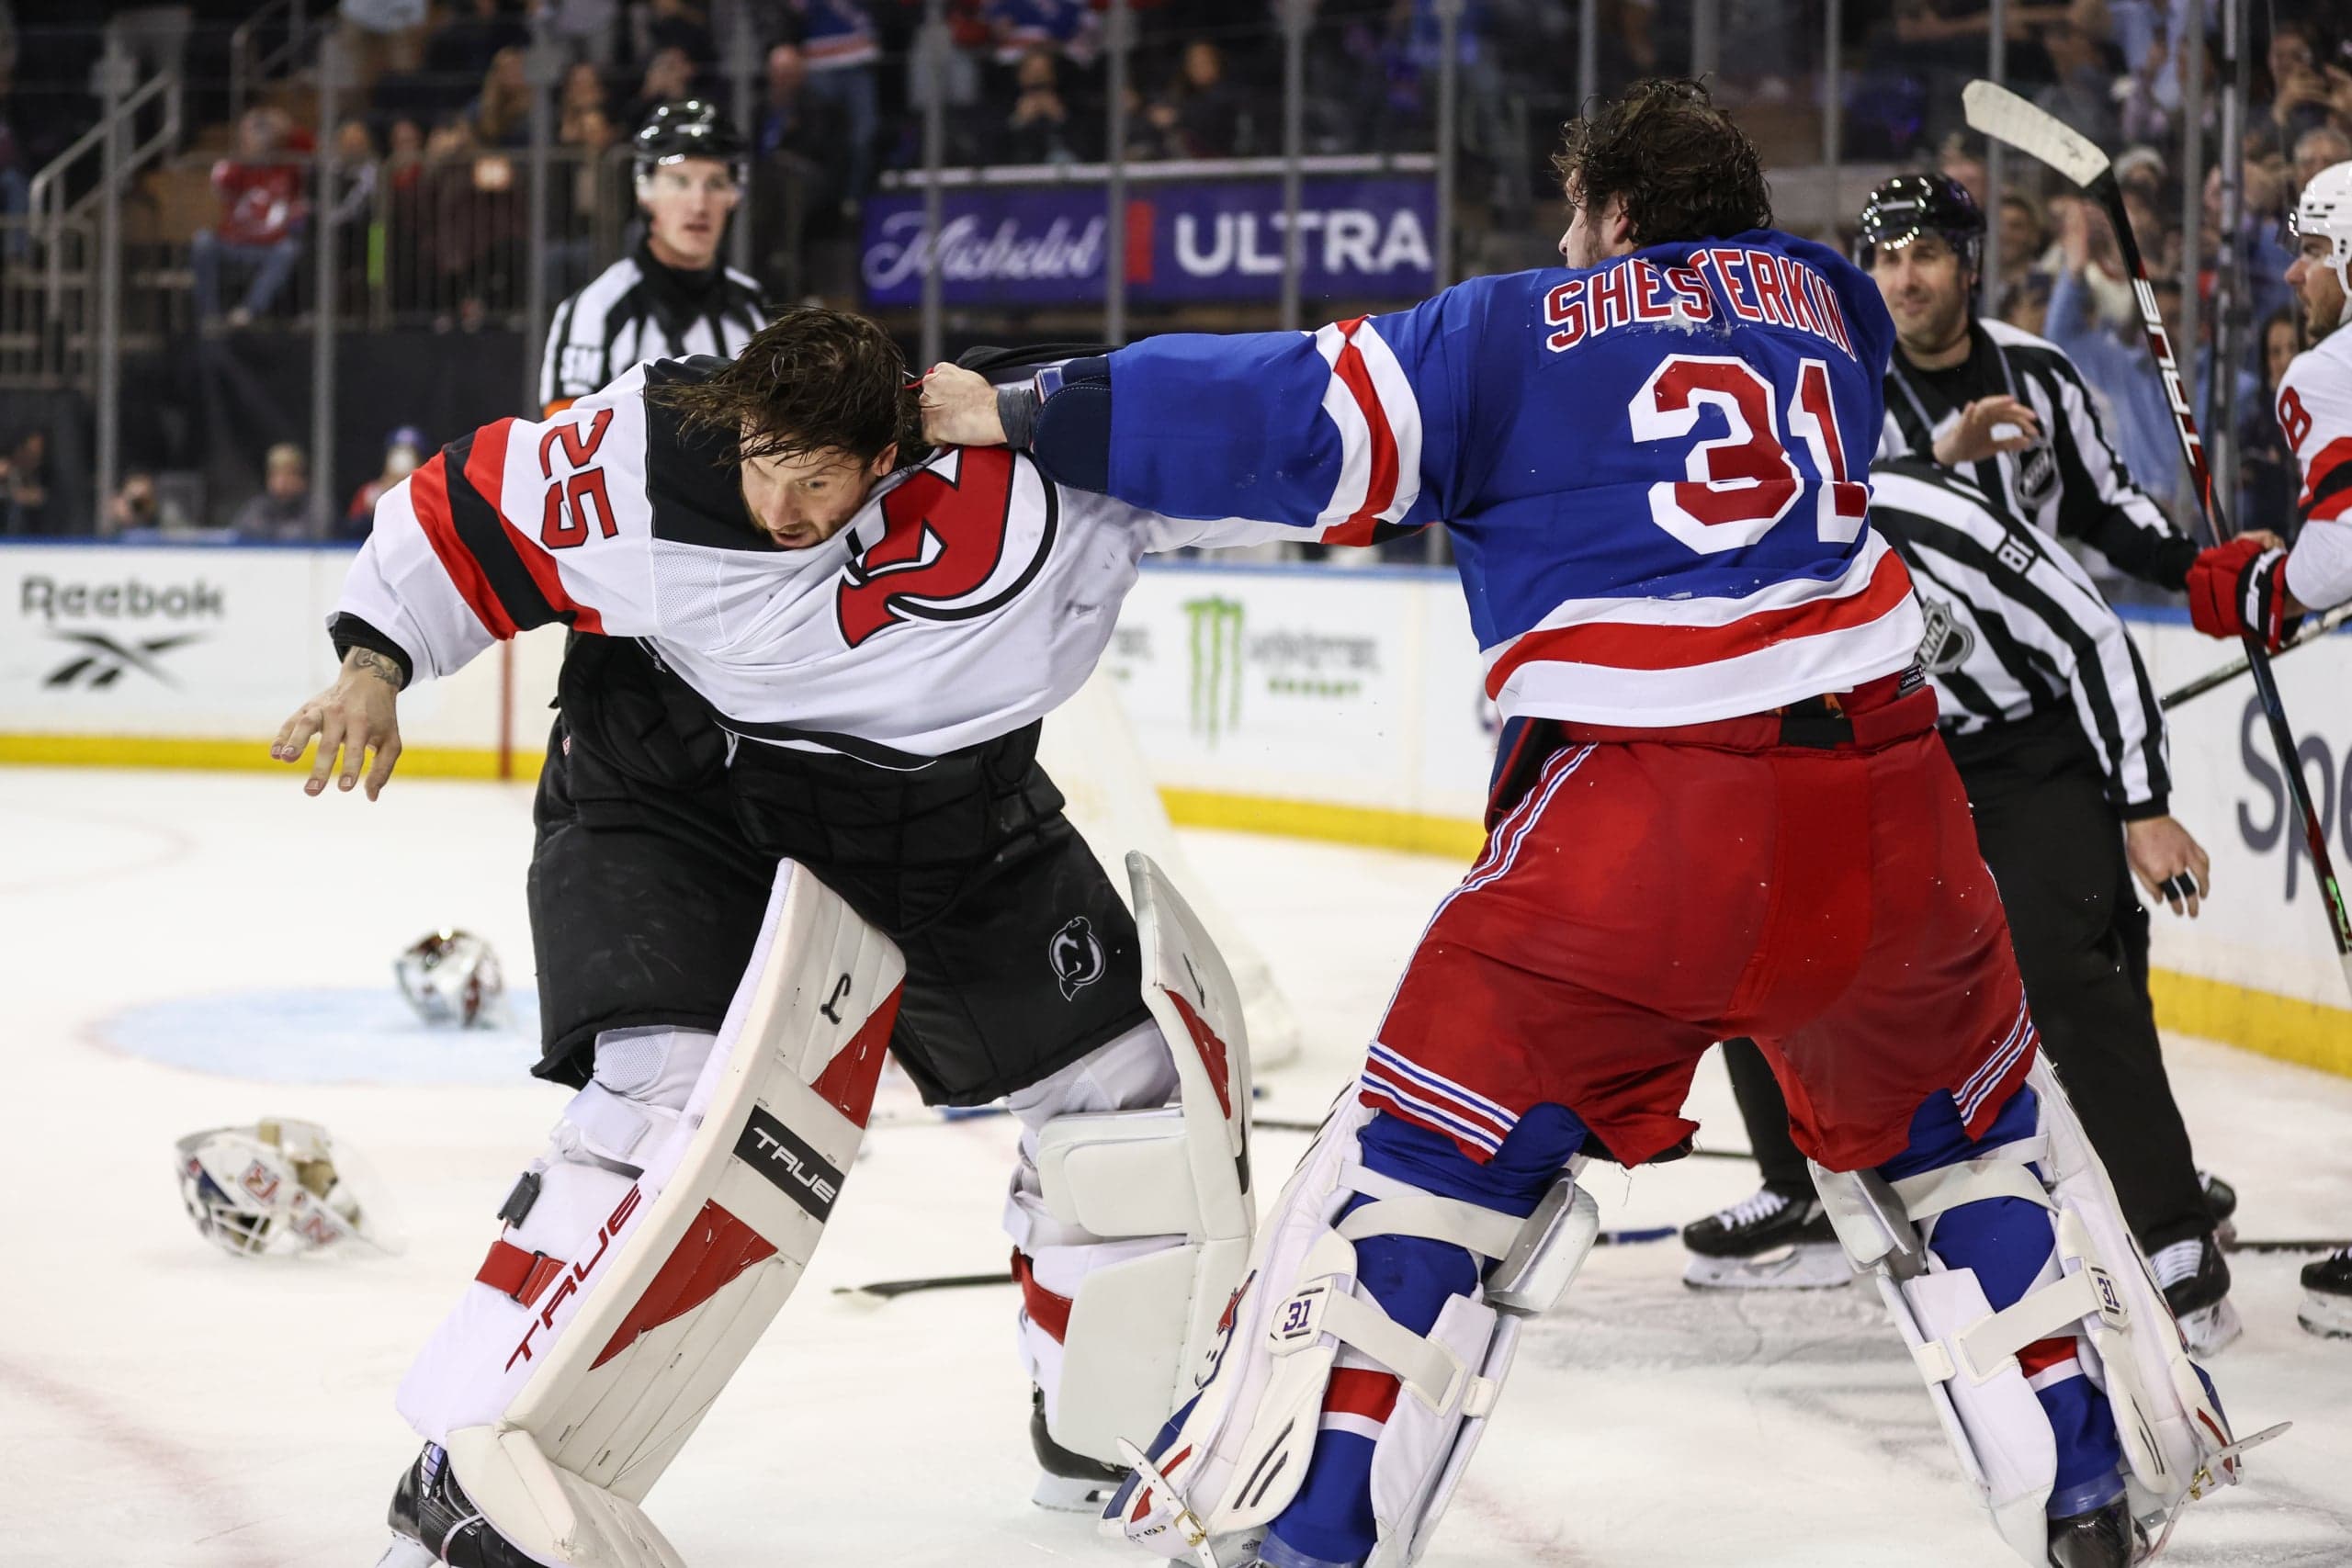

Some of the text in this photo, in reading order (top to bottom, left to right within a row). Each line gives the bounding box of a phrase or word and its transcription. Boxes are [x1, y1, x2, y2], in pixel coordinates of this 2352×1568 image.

[1175, 208, 1432, 276] ULTRA
[2133, 277, 2201, 467] TRUE
[539, 408, 619, 549] 25
[1628, 353, 1870, 555] 31
[21, 576, 224, 620] Reebok
[2238, 691, 2352, 902] Sp
[752, 1126, 837, 1204] TRUE
[504, 1182, 641, 1373] TRUE
[1283, 1299, 1312, 1332] 31
[2098, 1277, 2120, 1308] 31
